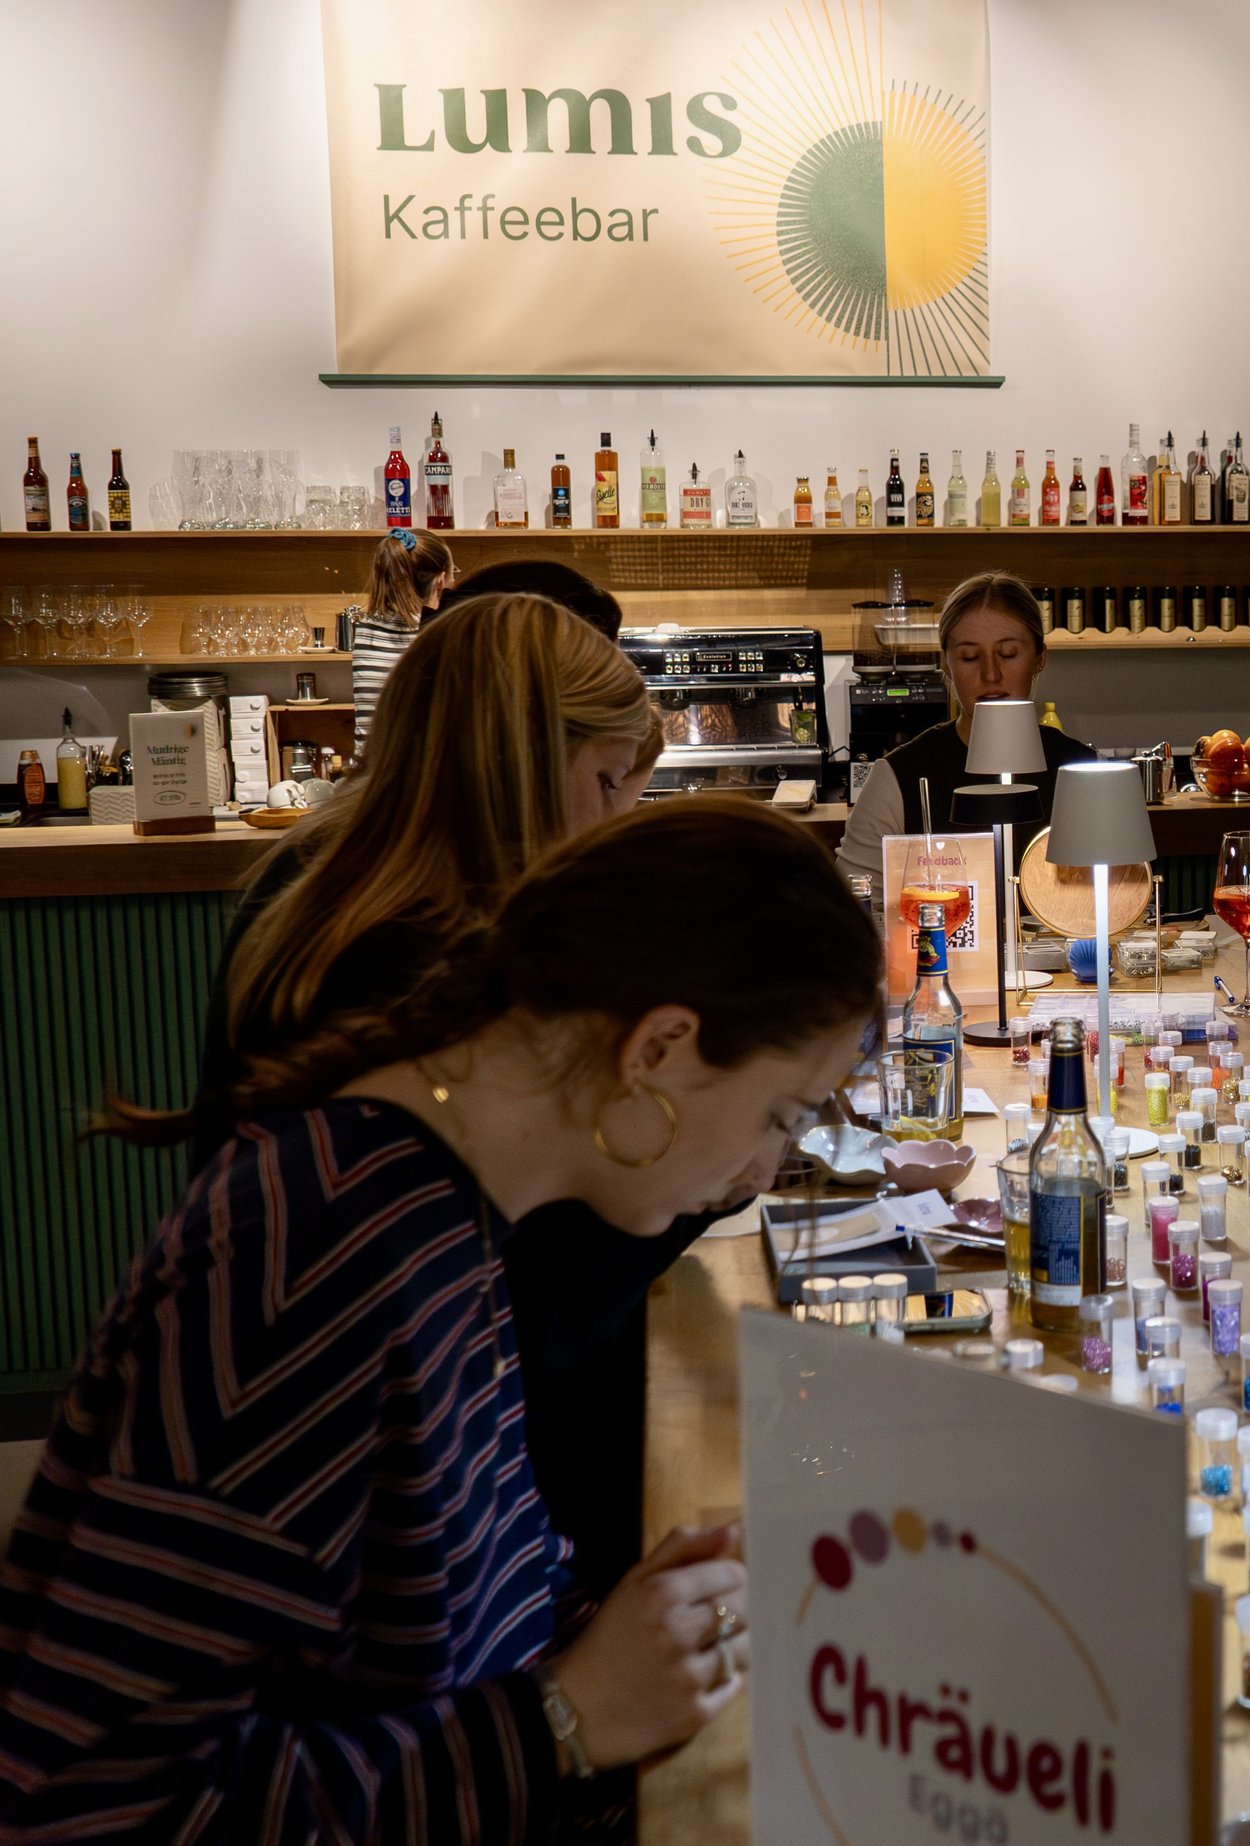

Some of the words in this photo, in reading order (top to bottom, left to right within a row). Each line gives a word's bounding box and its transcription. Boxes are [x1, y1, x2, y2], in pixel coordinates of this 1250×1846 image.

[382, 193, 659, 243] Kaffeebar
[690, 497, 704, 508] DRY
[809, 1641, 1116, 1833] Chräueli
